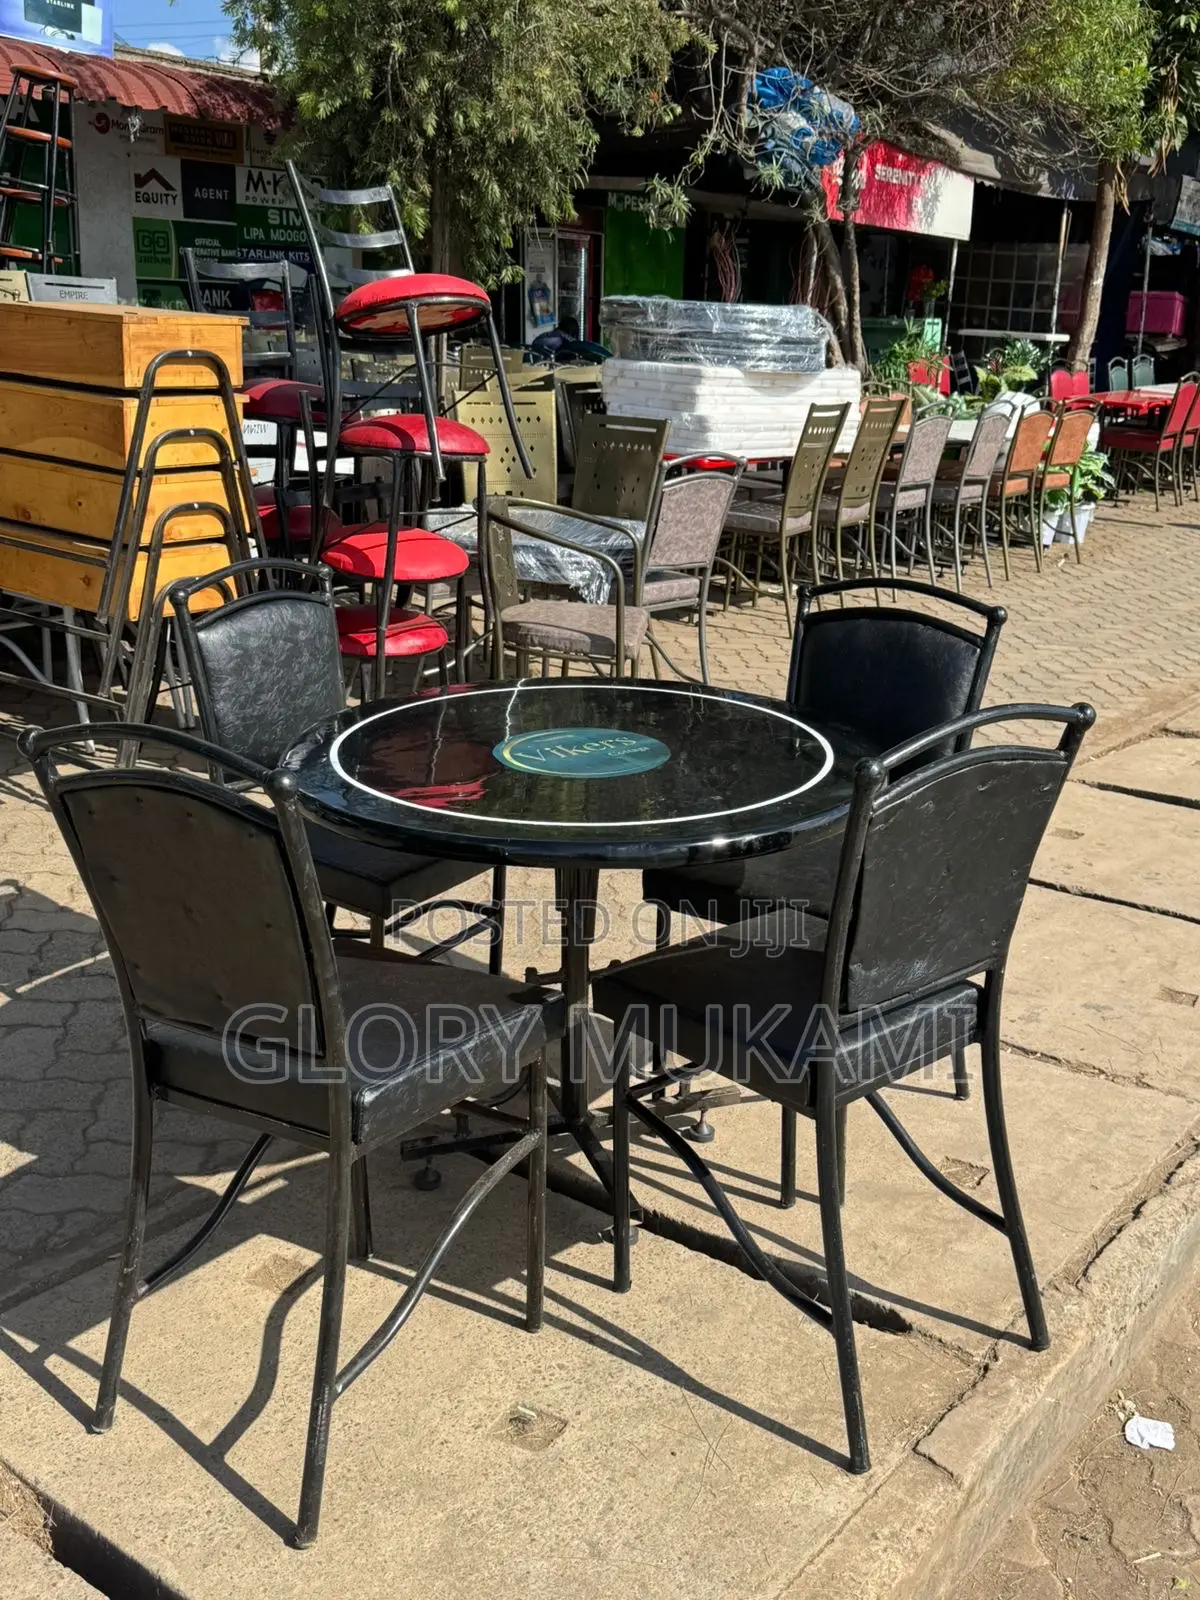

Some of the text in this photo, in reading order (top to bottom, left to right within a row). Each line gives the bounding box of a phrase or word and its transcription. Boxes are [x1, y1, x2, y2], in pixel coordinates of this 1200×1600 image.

[874, 163, 920, 186] SERENITY
[135, 191, 178, 206] EQUITY
[194, 187, 230, 201] AGENT
[243, 227, 308, 242] LIPA MDOGO
[236, 247, 311, 262] STARLINK KITS
[59, 289, 88, 300] EMPIRE
[513, 735, 637, 763] Vikers
